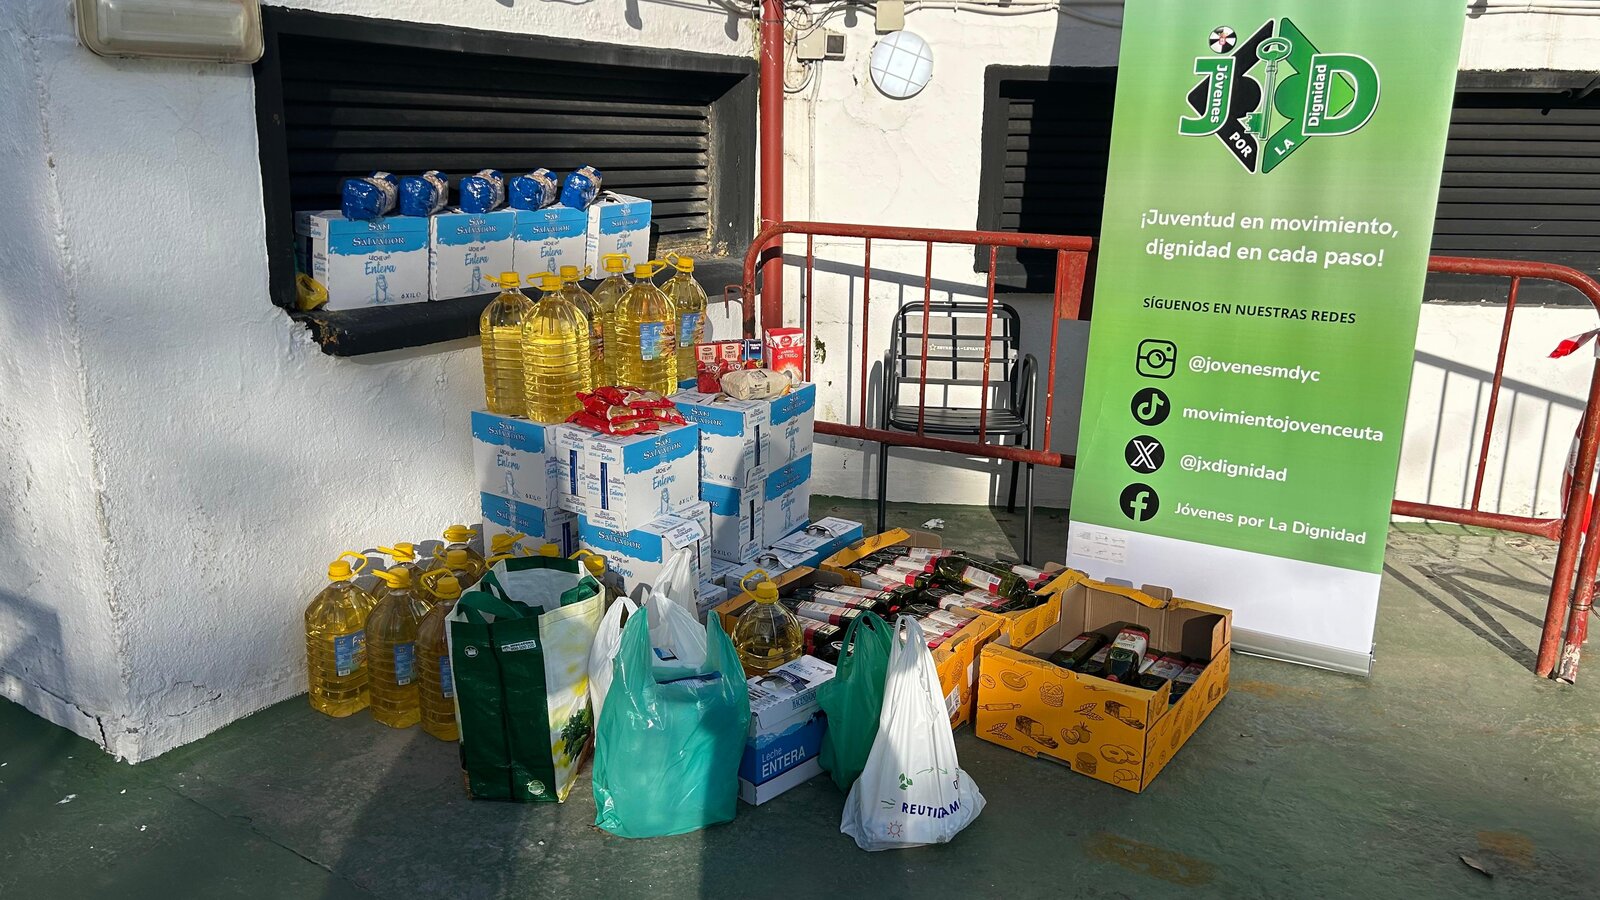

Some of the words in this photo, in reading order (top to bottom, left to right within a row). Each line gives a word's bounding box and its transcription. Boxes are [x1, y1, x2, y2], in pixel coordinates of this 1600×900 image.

[1210, 64, 1228, 124] Jóvenes
[1308, 64, 1327, 127] Dignidad
[1229, 132, 1253, 158] POR
[1274, 137, 1295, 156] LA
[1141, 209, 1235, 229] ¡Juventud
[1240, 215, 1264, 230] en
[1270, 215, 1399, 238] movimiento,
[364, 261, 397, 275] Entera
[1146, 238, 1231, 260] dignidad
[1236, 246, 1262, 260] en
[1268, 246, 1318, 264] cada
[1324, 249, 1385, 269] paso!
[1143, 296, 1210, 312] SÍGUENOS
[1213, 303, 1231, 314] EN
[1234, 304, 1307, 321] NUESTRAS
[1311, 310, 1356, 324] REDES
[1188, 355, 1321, 384] @jovenesmdyc
[1182, 406, 1384, 442] movimientojovenceuta
[1180, 454, 1288, 483] @jxdignidad
[1174, 502, 1234, 523] Jóvenes
[1237, 515, 1264, 528] por
[1269, 517, 1287, 532] La
[1292, 521, 1367, 545] Dignidad
[761, 747, 783, 763] Leche
[762, 746, 806, 778] ENTERA
